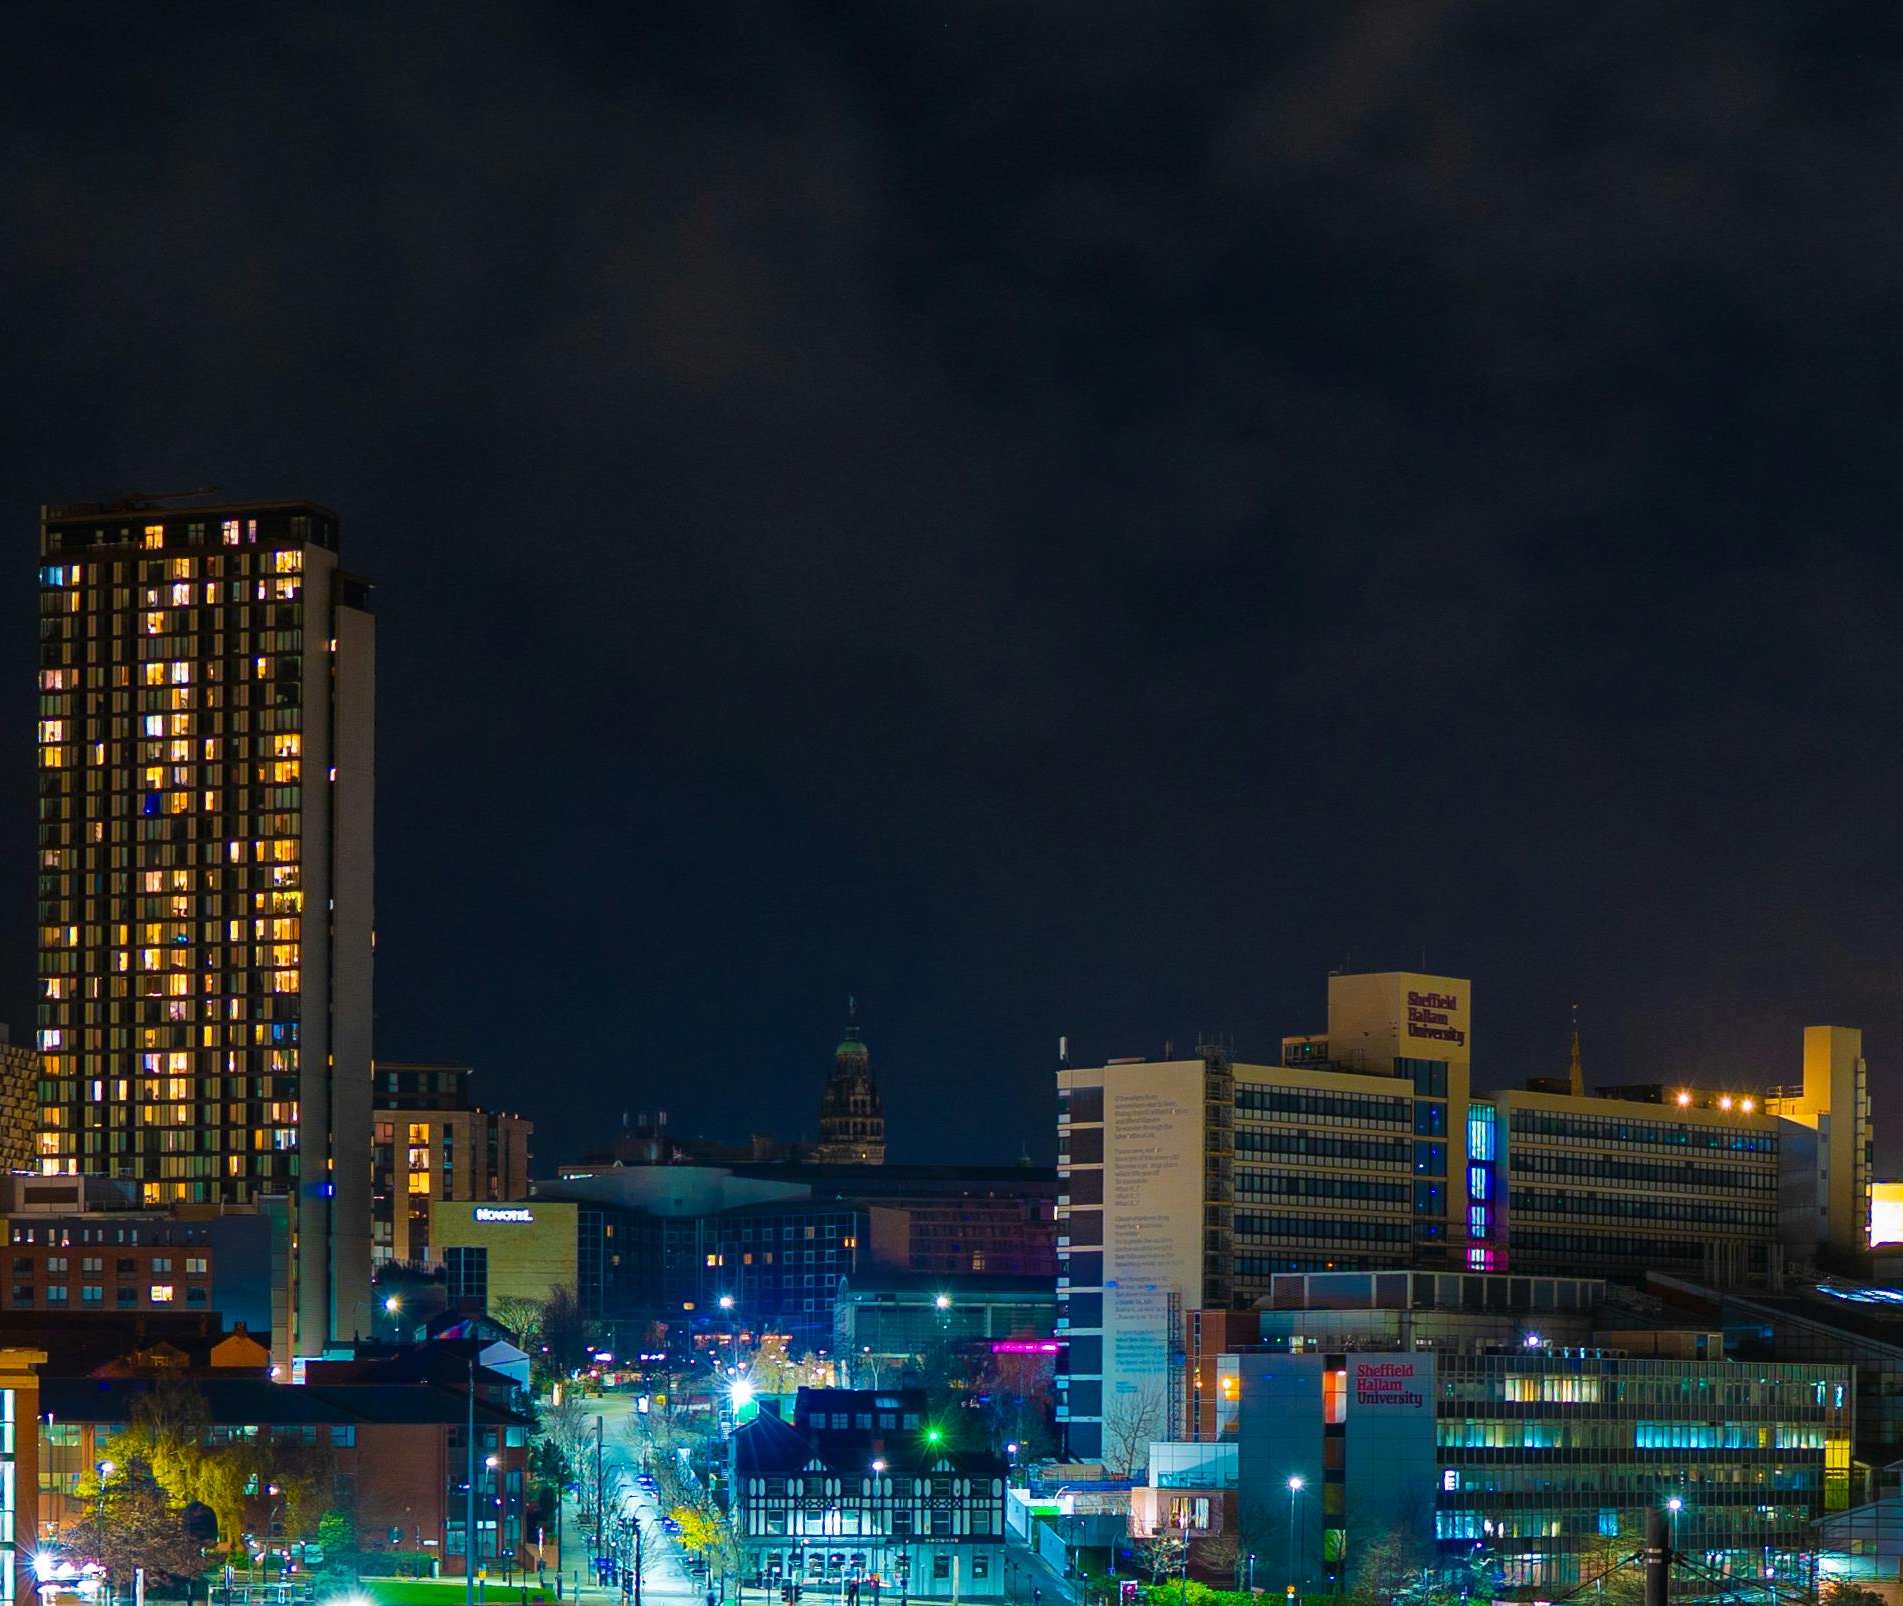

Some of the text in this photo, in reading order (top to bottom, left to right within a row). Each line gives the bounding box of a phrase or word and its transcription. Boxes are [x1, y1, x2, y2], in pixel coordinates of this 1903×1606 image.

[1408, 991, 1457, 1010] Sheffield
[1408, 1007, 1448, 1025] Hallam
[1408, 1023, 1465, 1047] University
[1357, 1363, 1414, 1377] Sheffield
[1357, 1378, 1402, 1391] Hallam
[1357, 1391, 1423, 1408] University
